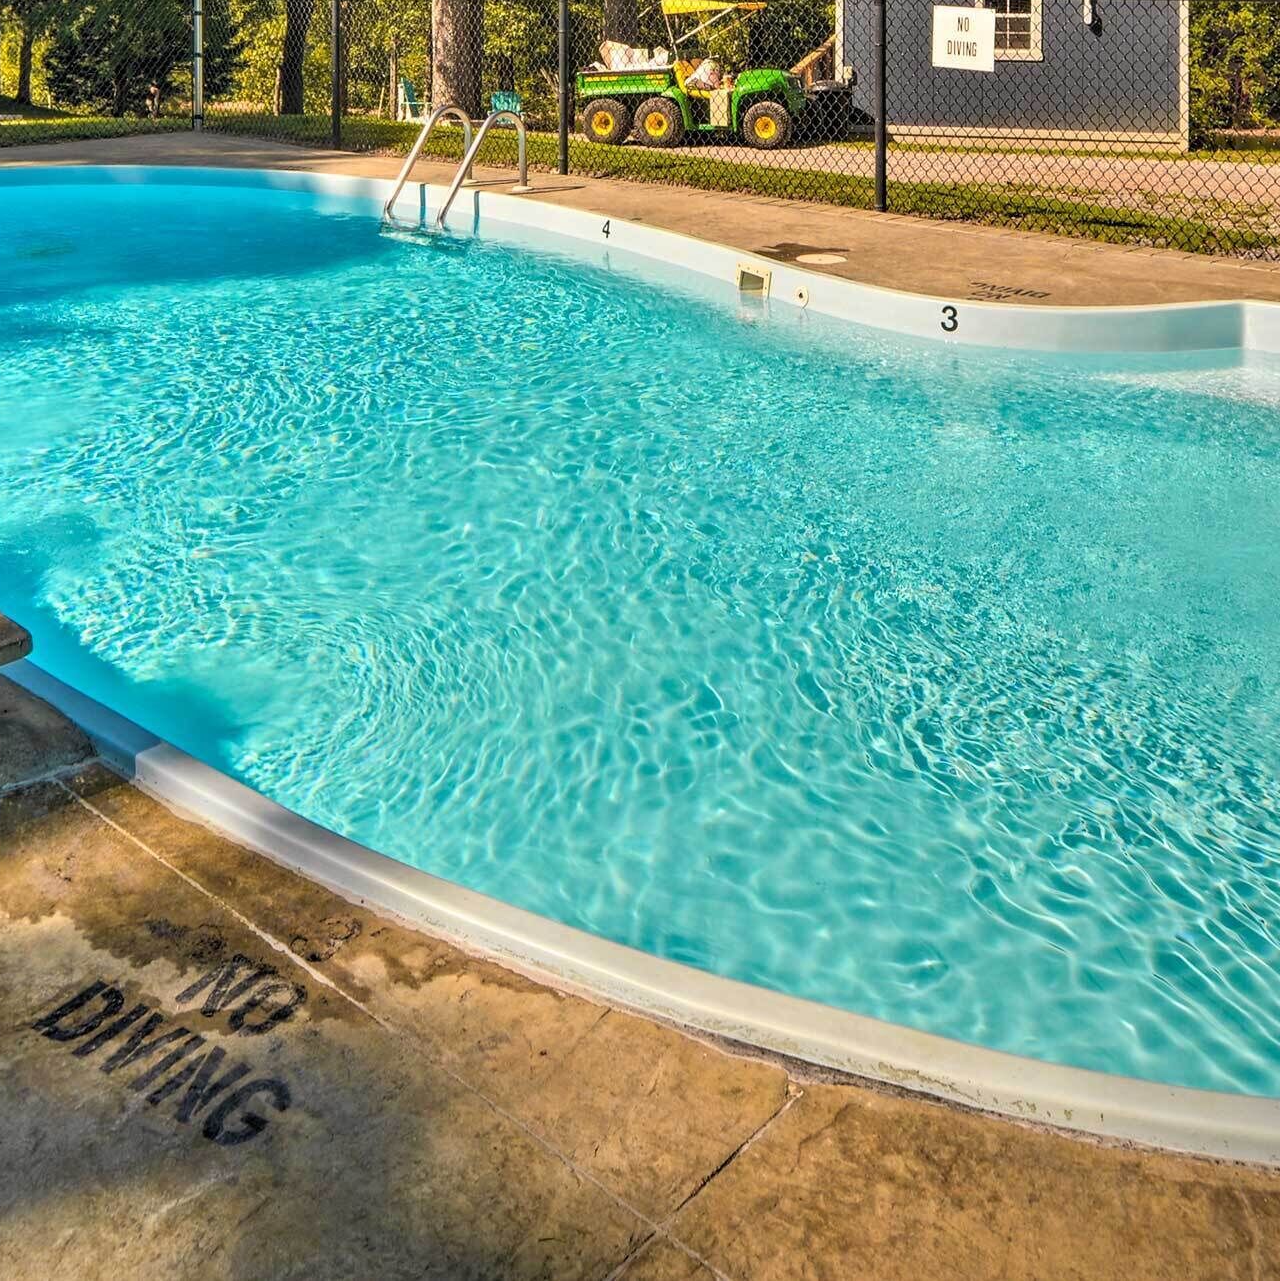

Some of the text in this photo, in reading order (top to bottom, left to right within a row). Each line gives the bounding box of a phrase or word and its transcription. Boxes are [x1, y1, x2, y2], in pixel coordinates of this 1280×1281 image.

[957, 16, 970, 32] NO
[947, 39, 977, 57] DIVING
[602, 219, 610, 239] 4
[940, 305, 958, 332] 3
[174, 953, 308, 1037] NO
[31, 979, 291, 1146] DIVING
